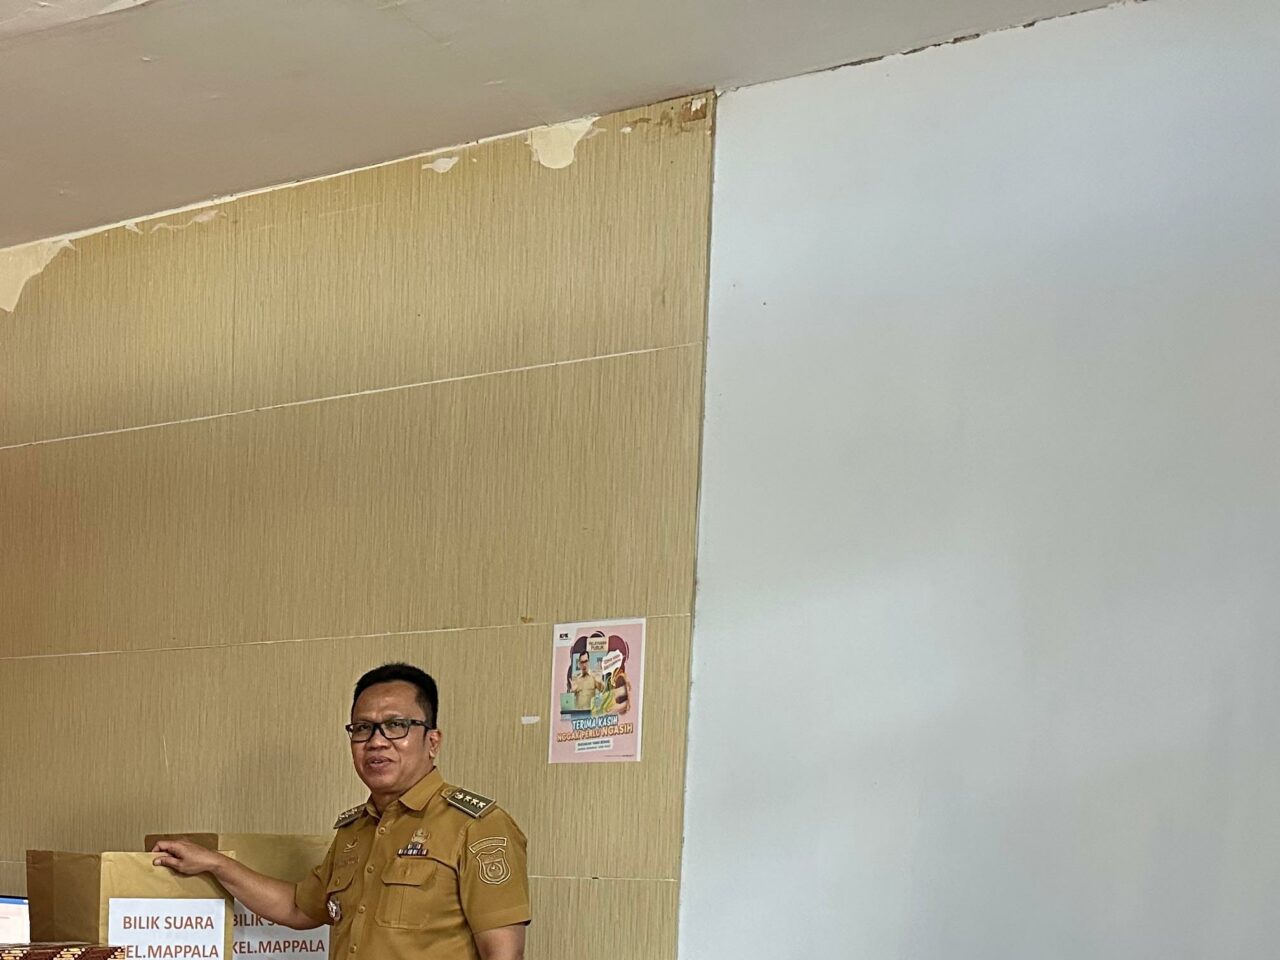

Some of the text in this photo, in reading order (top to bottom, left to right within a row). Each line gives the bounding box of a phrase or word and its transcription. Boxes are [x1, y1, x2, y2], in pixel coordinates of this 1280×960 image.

[572, 714, 619, 731] TERIMA KASIH
[601, 723, 634, 737] NGASIH
[123, 916, 215, 930] BILIK SUARA
[125, 945, 219, 959] EL.MAPPALA
